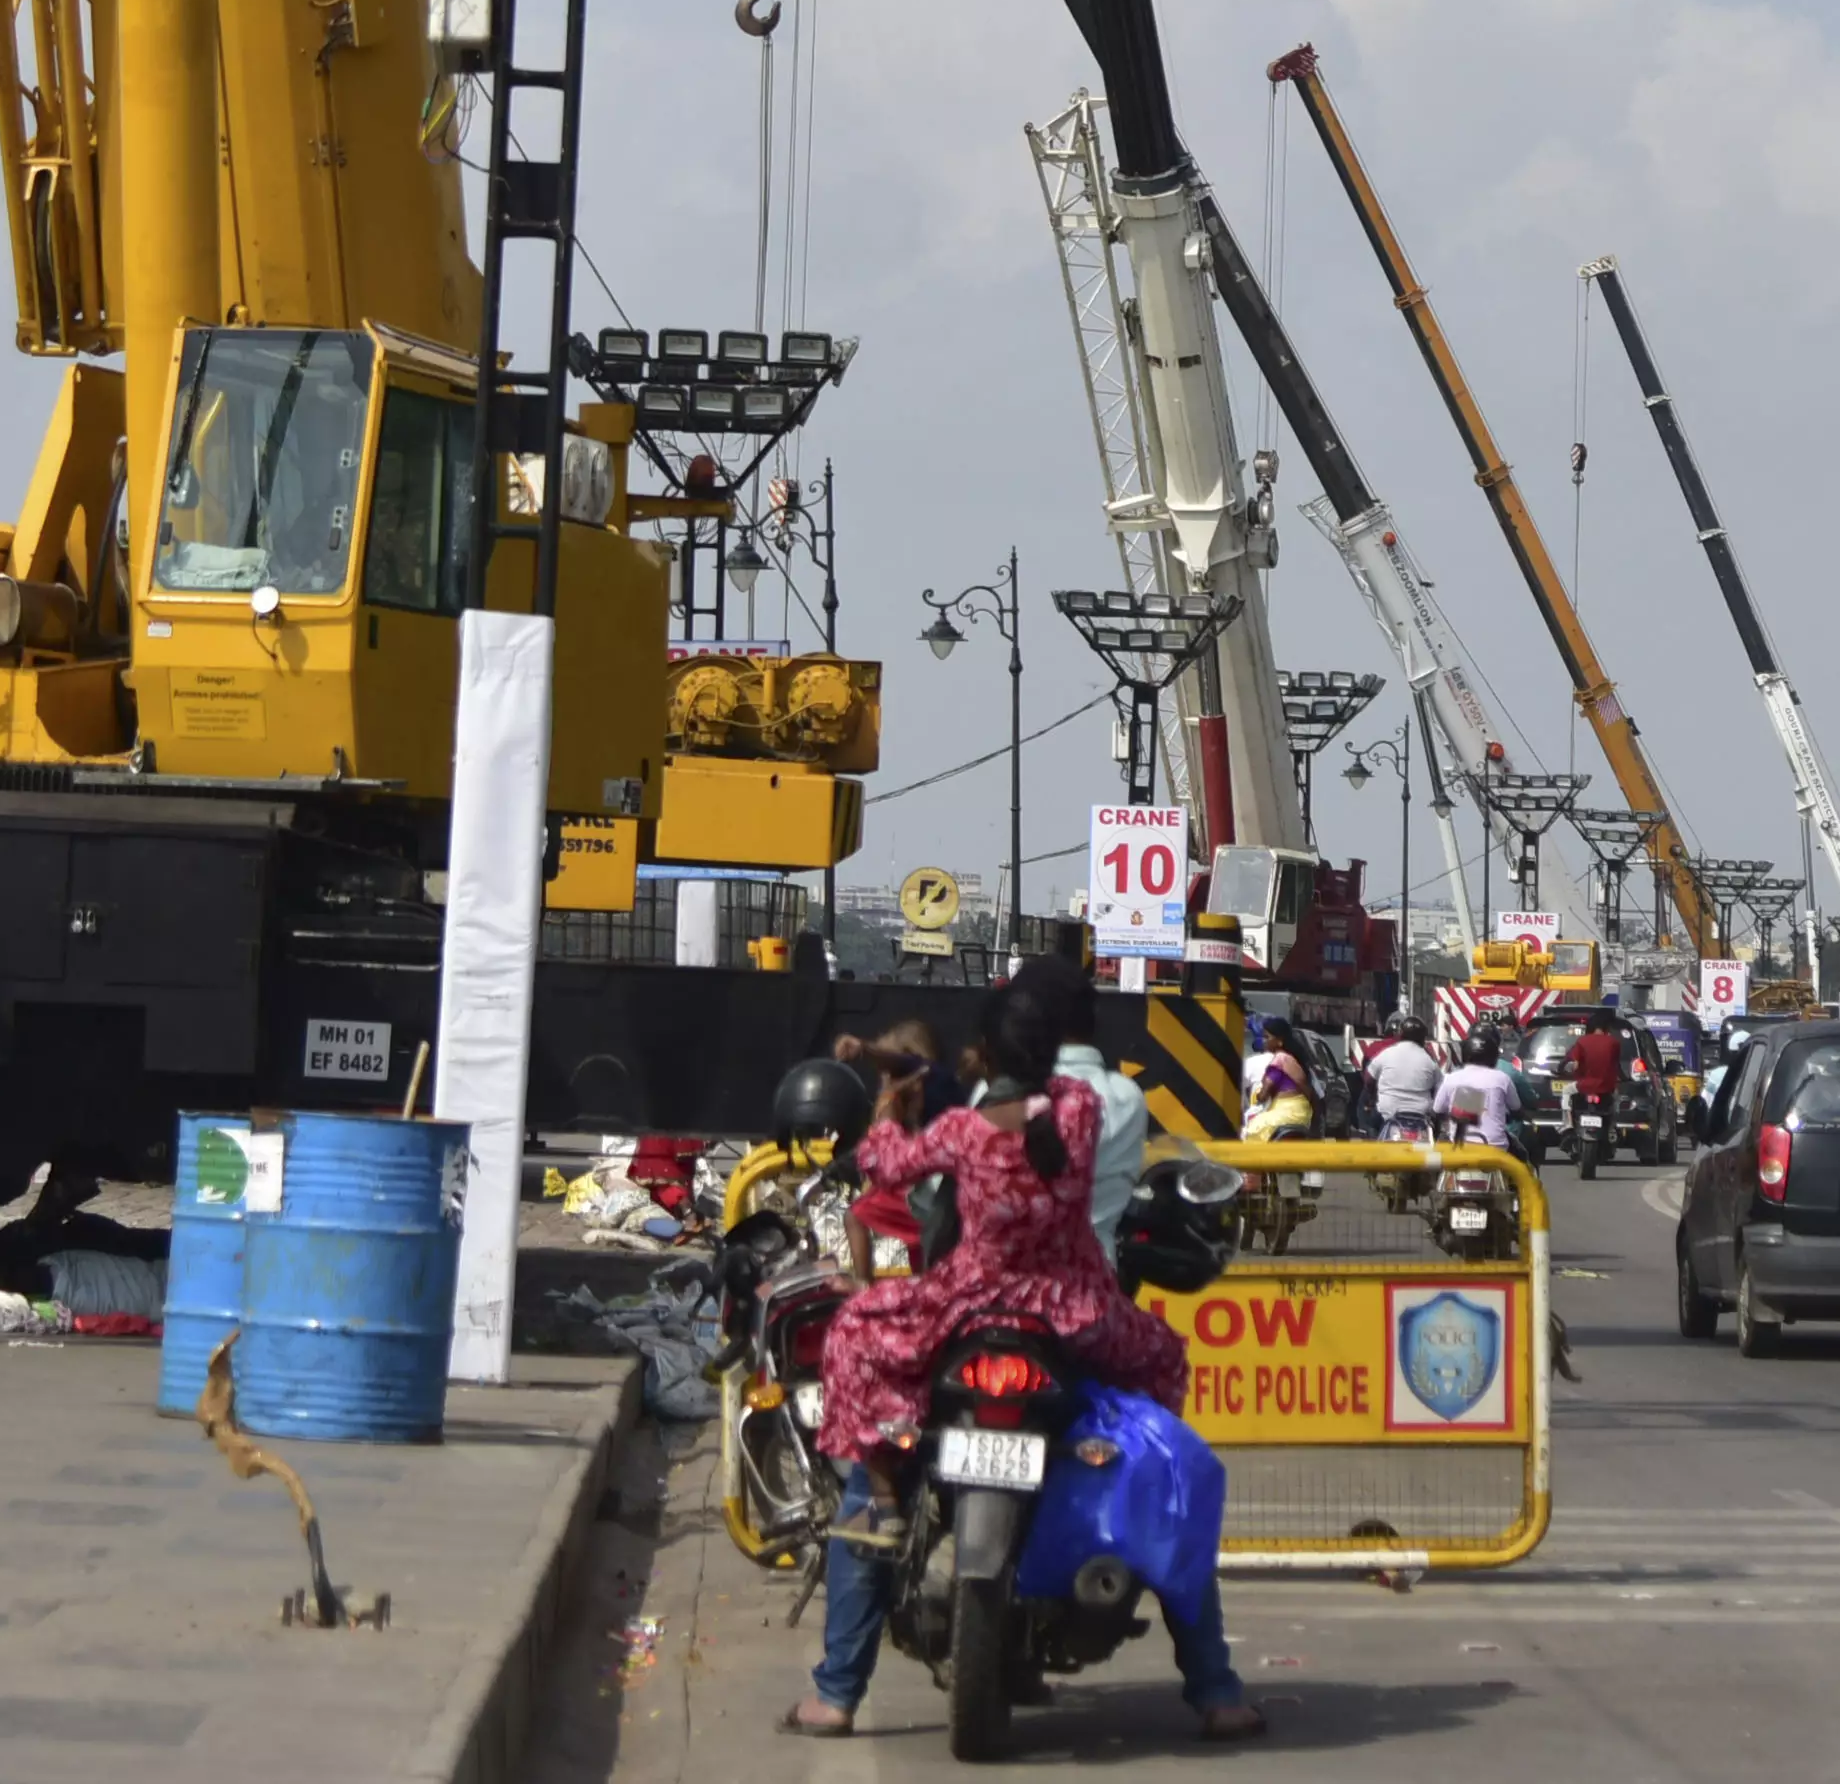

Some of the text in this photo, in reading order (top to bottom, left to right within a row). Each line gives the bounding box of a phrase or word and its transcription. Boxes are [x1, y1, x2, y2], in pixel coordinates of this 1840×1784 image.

[1396, 563, 1433, 627] ZOOMLION
[1098, 808, 1180, 827] CRANE
[1103, 843, 1175, 896] 10
[1502, 913, 1555, 926] CRANE
[1704, 961, 1743, 971] CRANE
[1712, 976, 1734, 1003] 8
[319, 1023, 375, 1045] MH 01
[310, 1051, 384, 1072] EF 8482
[1256, 1364, 1370, 1415] POLICE
